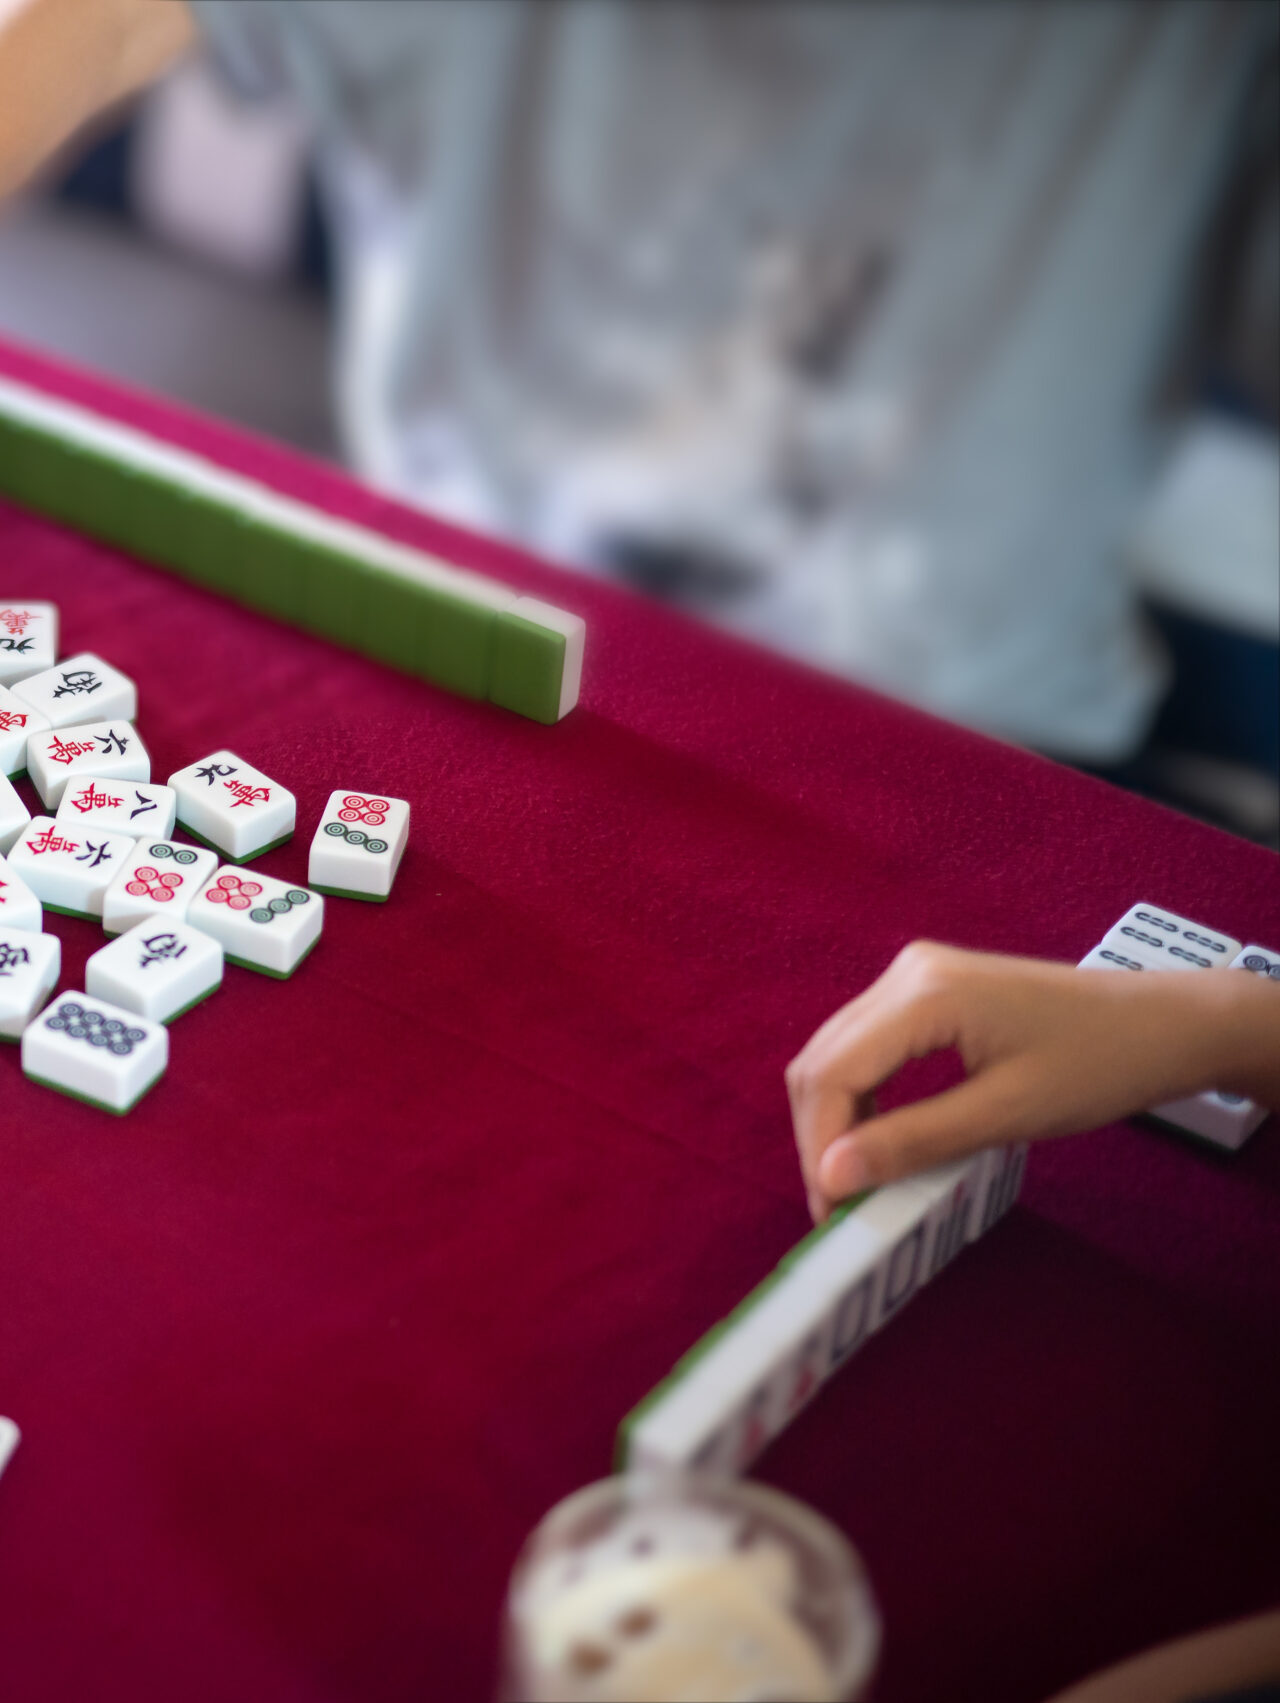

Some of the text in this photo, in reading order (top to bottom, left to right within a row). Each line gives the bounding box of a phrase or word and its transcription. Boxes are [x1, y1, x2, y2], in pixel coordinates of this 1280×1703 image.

[53, 671, 103, 698] 南
[48, 729, 129, 765] 六萬
[71, 782, 158, 820] 八萬
[196, 764, 271, 807] 九萬
[26, 826, 112, 867] 六萬
[141, 934, 188, 968] 南
